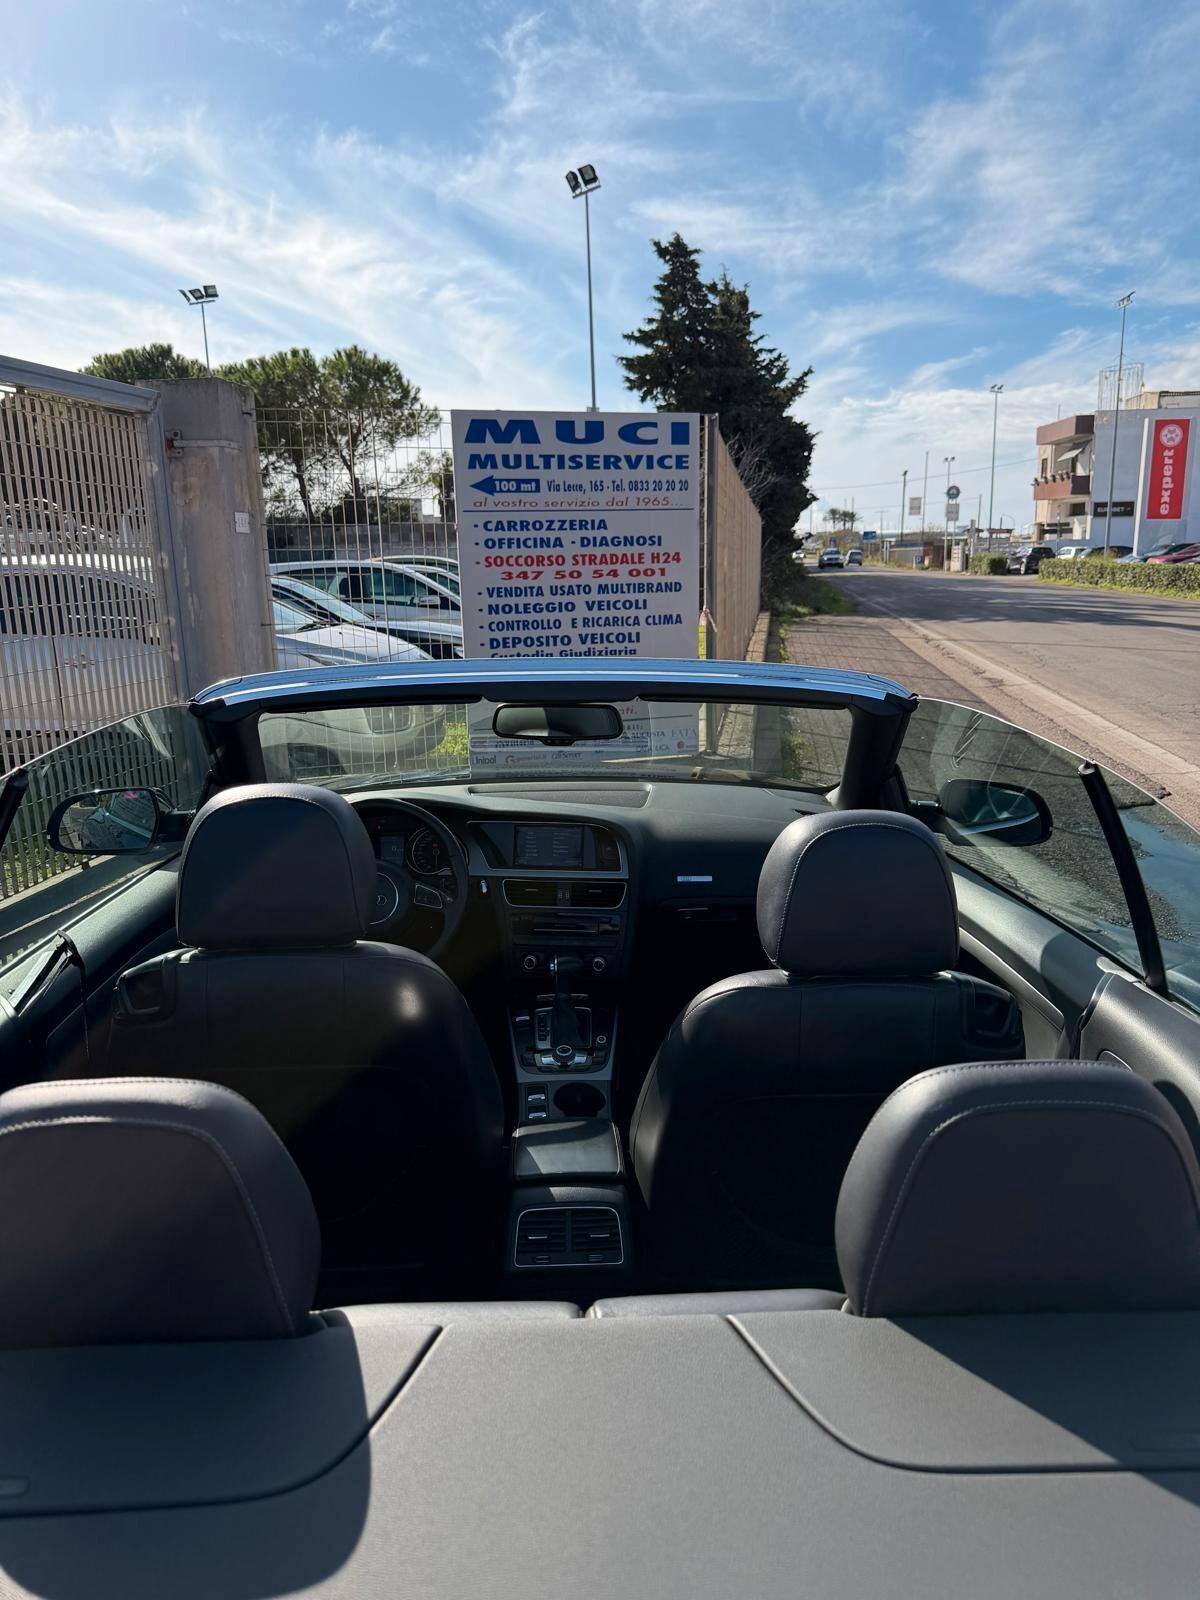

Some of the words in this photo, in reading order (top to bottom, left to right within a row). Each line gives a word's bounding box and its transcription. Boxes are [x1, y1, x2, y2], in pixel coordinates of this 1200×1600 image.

[464, 419, 690, 445] MUCI
[468, 454, 689, 470] MULTISERVICE
[494, 480, 517, 491] 100
[520, 481, 536, 491] mt
[547, 480, 561, 491] Via
[563, 480, 586, 494] Lecce,
[589, 480, 604, 491] 165
[612, 479, 626, 491] Tel.
[628, 480, 649, 491] 0833
[653, 480, 663, 491] 20
[666, 480, 676, 491] 20
[679, 480, 688, 491] 20
[1160, 448, 1174, 515] expert
[473, 498, 487, 507] al
[544, 498, 599, 507] servizio
[605, 498, 629, 507] dal
[483, 519, 608, 532] CARROZZERIA
[484, 537, 564, 549] OFFICINA
[580, 536, 662, 547] DIAGNOSI
[484, 555, 566, 568] SOCCORSO
[572, 553, 645, 565] STRADALE
[651, 552, 681, 564] H24
[500, 571, 543, 580] 347
[555, 570, 582, 579] 50
[591, 569, 619, 578] 54
[628, 568, 666, 577] 001
[487, 585, 544, 598] VENDITA
[550, 584, 592, 596] USATO
[597, 582, 682, 594] MULTIBRAND
[488, 601, 576, 615] NOLEGGIO
[585, 599, 647, 611] VEICOLI
[488, 619, 561, 632] CONTROLLO
[571, 618, 577, 629] E
[582, 616, 640, 628] RICARICA
[645, 614, 683, 625] CLIMA
[489, 635, 572, 649] DEPOSITO
[579, 632, 641, 645] VEICOLI
[559, 647, 637, 657] Giudiziaria
